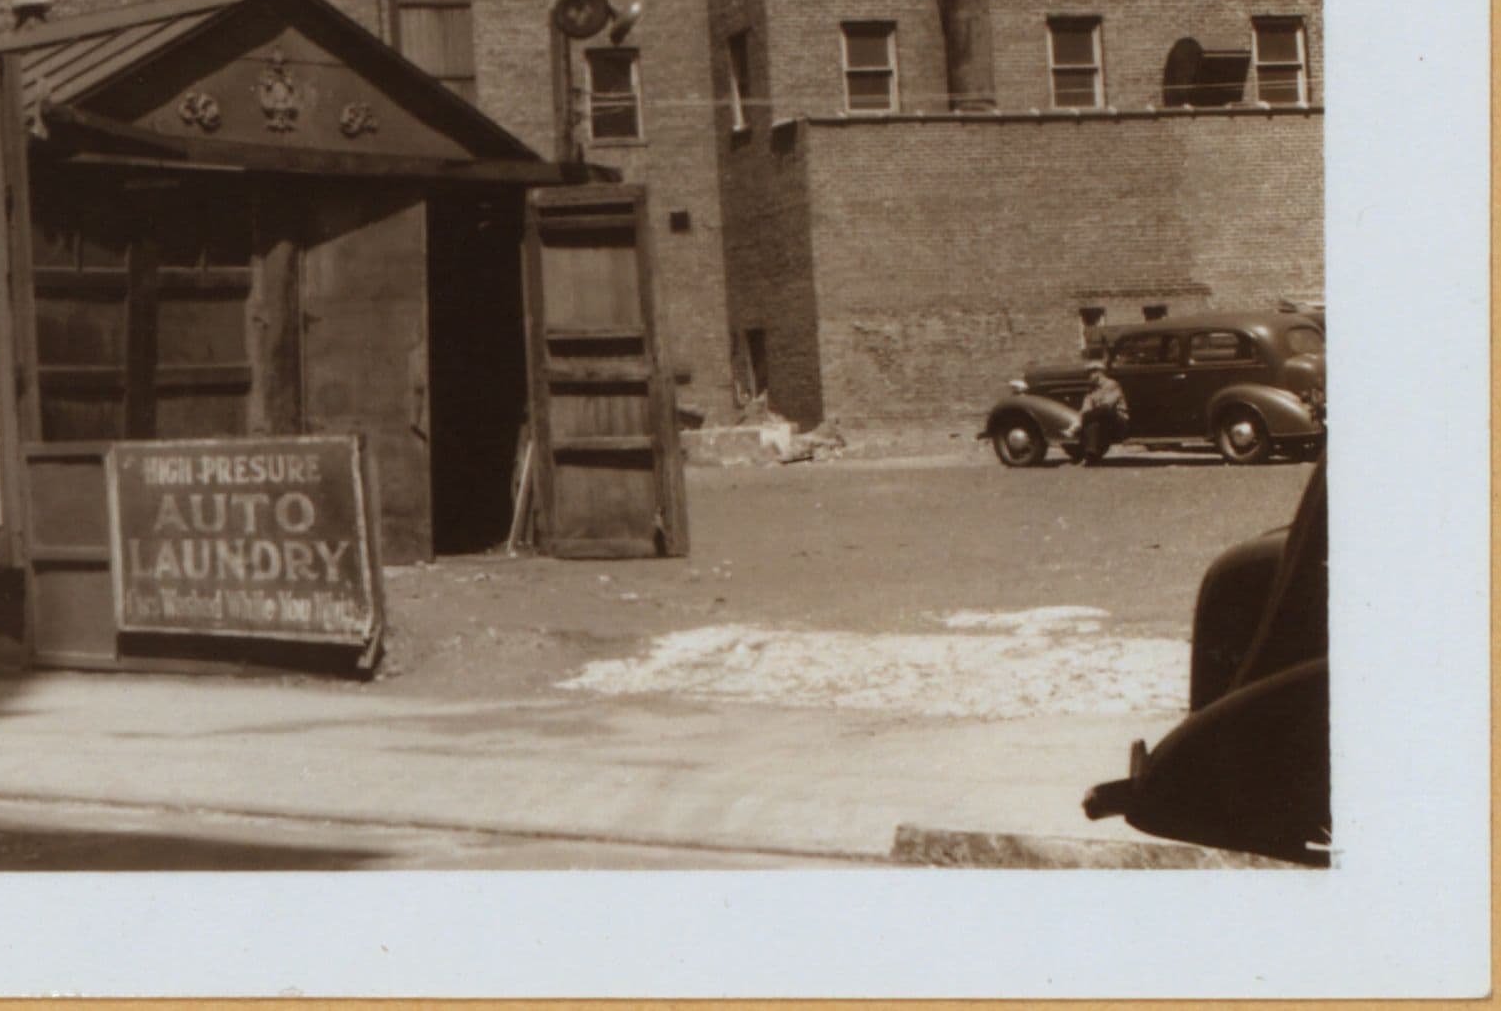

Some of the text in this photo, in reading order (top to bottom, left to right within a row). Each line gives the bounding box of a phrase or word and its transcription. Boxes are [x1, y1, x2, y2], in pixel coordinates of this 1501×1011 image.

[144, 455, 193, 485] HIGH
[154, 492, 315, 534] AUTO
[128, 539, 349, 582] LAUNDRY
